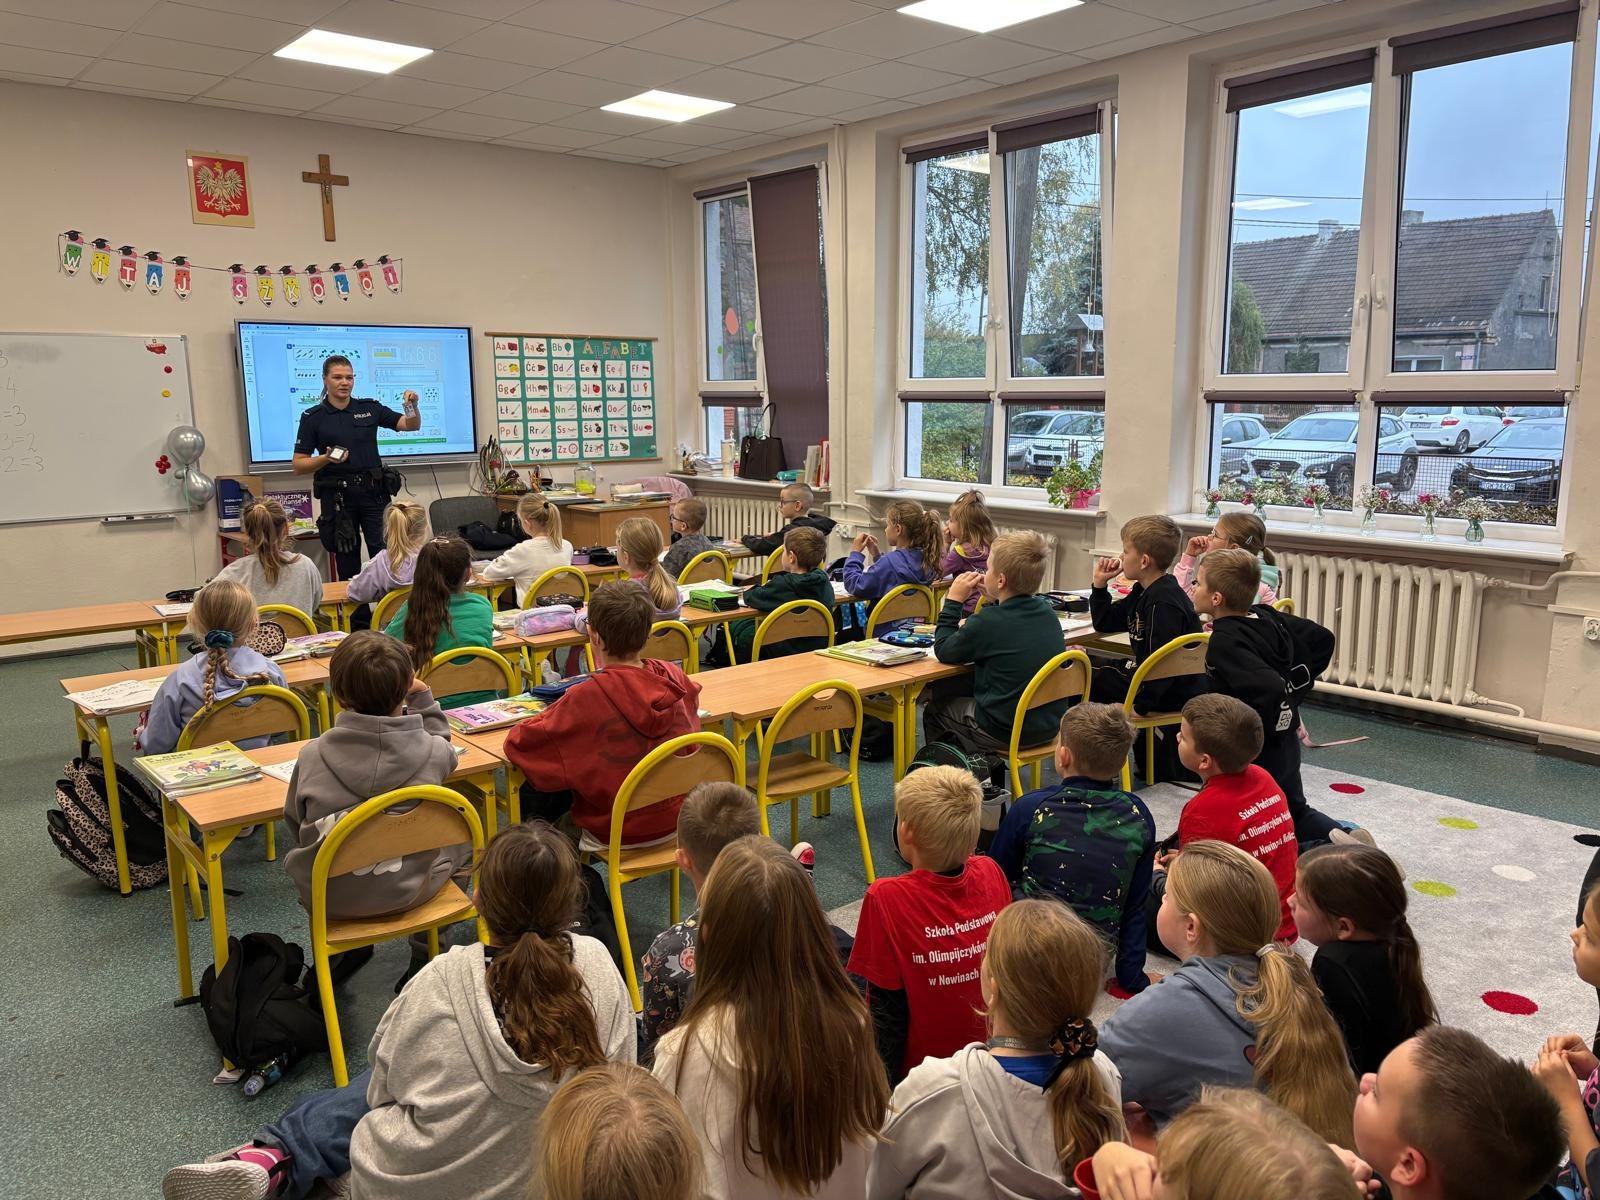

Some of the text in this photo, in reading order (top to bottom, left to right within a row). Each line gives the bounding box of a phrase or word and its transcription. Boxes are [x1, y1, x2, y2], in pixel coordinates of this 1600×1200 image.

[66, 251, 187, 291] WITAJ
[495, 341, 506, 350] Aa
[552, 342, 562, 351] Bb
[582, 341, 648, 360] ALFABET
[497, 362, 508, 371] Cc
[553, 363, 564, 372] Dd
[580, 364, 590, 372] Ee
[631, 364, 640, 372] Ff
[498, 384, 509, 394] Gg
[526, 384, 538, 392] Hh
[582, 384, 590, 394] Jj
[607, 384, 617, 392] Kk
[527, 405, 539, 414] Mm
[555, 405, 566, 413] Nn
[607, 404, 617, 412] Oo
[500, 426, 511, 437] Pp
[529, 426, 540, 434] Rr
[556, 425, 566, 433] Ss
[609, 424, 617, 432] Tt
[633, 423, 643, 431] Uu
[529, 446, 540, 456] Yy
[557, 446, 567, 454] Zz
[1238, 805, 1260, 820] Szkoła
[925, 910, 997, 938] Szkoła Podstawowa
[912, 940, 987, 964] im. Olimpijczyków
[928, 968, 980, 986] w Nowinach
